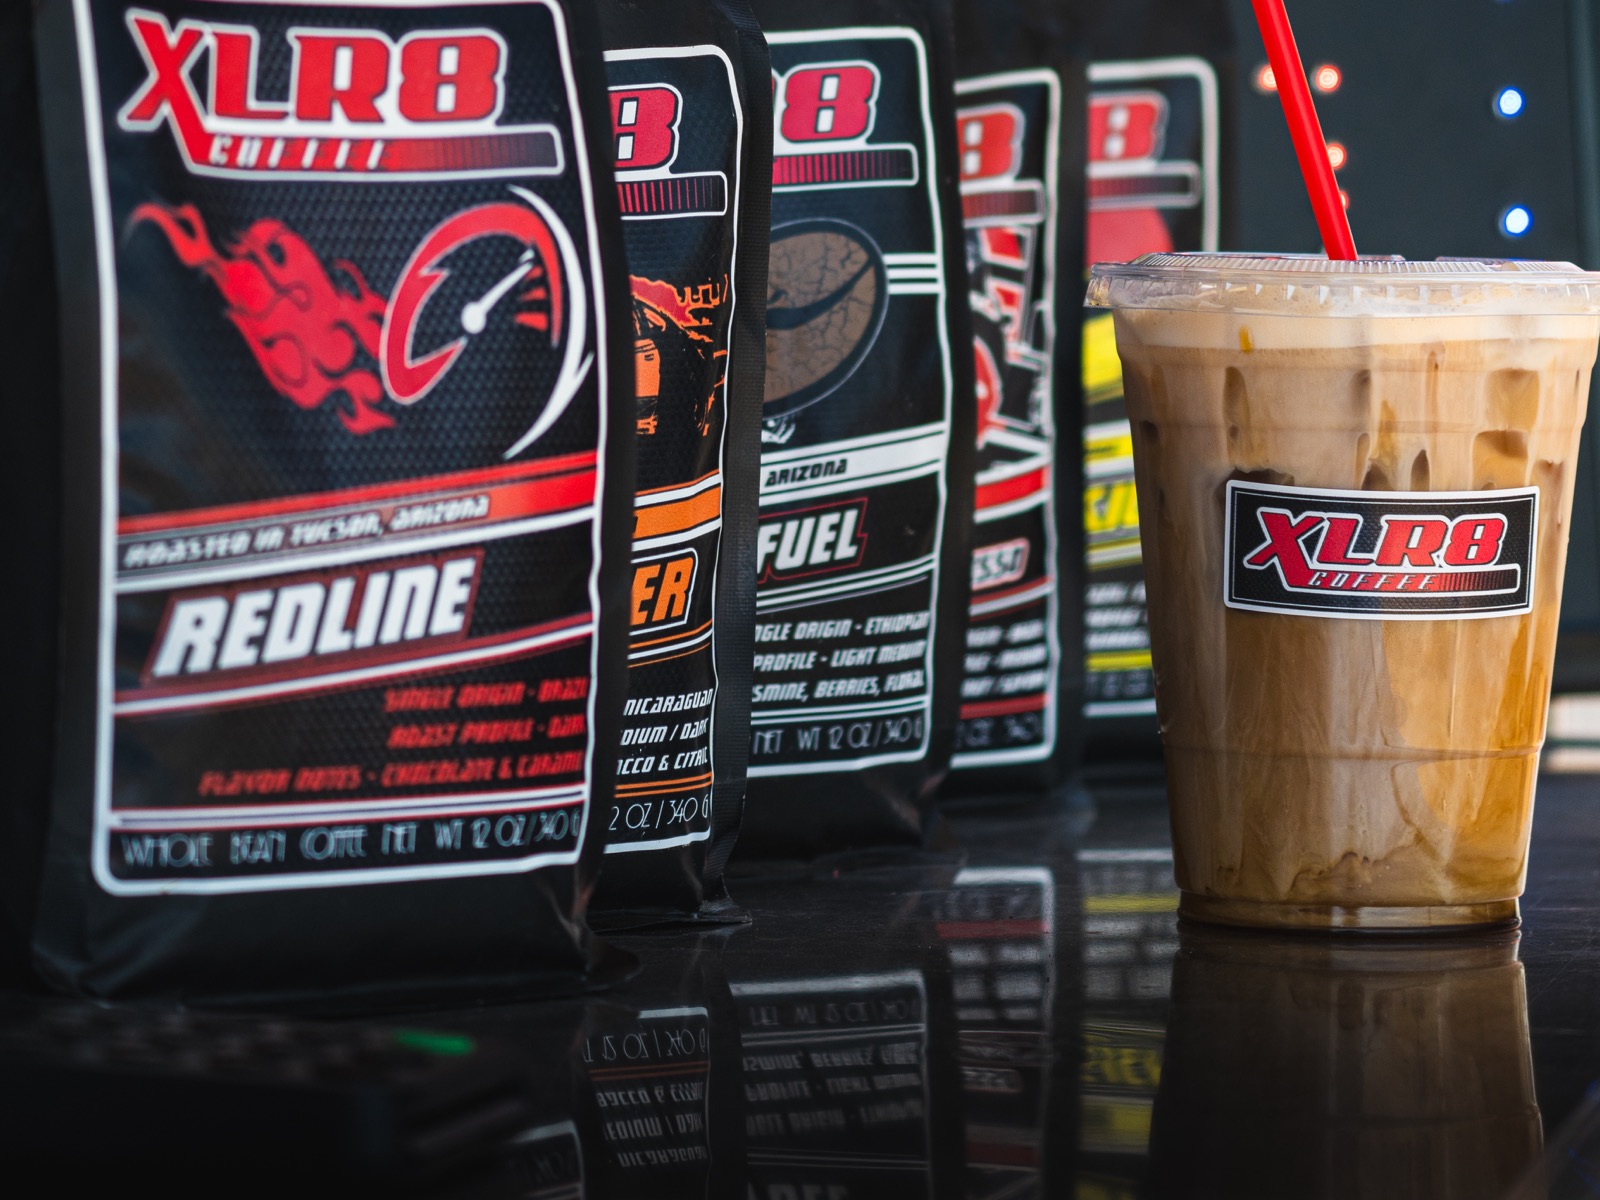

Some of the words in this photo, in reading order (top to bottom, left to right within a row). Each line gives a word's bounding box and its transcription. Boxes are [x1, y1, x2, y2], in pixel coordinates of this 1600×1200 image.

[120, 8, 507, 130] XLR8
[764, 458, 848, 488] ARIZONA
[123, 530, 250, 569] ROASTED
[253, 526, 285, 552] IN
[289, 511, 384, 546] TUCSON,
[389, 495, 490, 532] ARIZONA
[757, 508, 860, 574] FUEL
[1245, 508, 1507, 568] XLR8
[630, 556, 694, 626] ER
[1307, 571, 1440, 590] COFFEE
[151, 556, 477, 678] REDLINE
[793, 619, 852, 640] ORIGIN
[753, 651, 818, 672] PROFILE
[830, 646, 878, 667] LIGHT
[384, 686, 454, 714] SINGLE
[457, 682, 526, 708] ORIGIN
[623, 688, 713, 715] NICARAGUAN
[814, 676, 881, 699] BERRIES,
[387, 723, 457, 748] ROAST
[459, 718, 535, 744] PROFILE
[680, 718, 709, 740] DARK
[674, 746, 708, 770] CITRIC
[198, 769, 291, 796] FLAVOR
[294, 765, 361, 792] NOTES
[381, 758, 495, 787] CHOCOLATE
[626, 802, 652, 829] OZ
[667, 797, 698, 825] 340
[121, 833, 213, 867] WHOLE
[231, 829, 286, 864] BEAN
[302, 825, 368, 861] COFFEE
[382, 822, 416, 854] NET
[434, 819, 465, 849] WT
